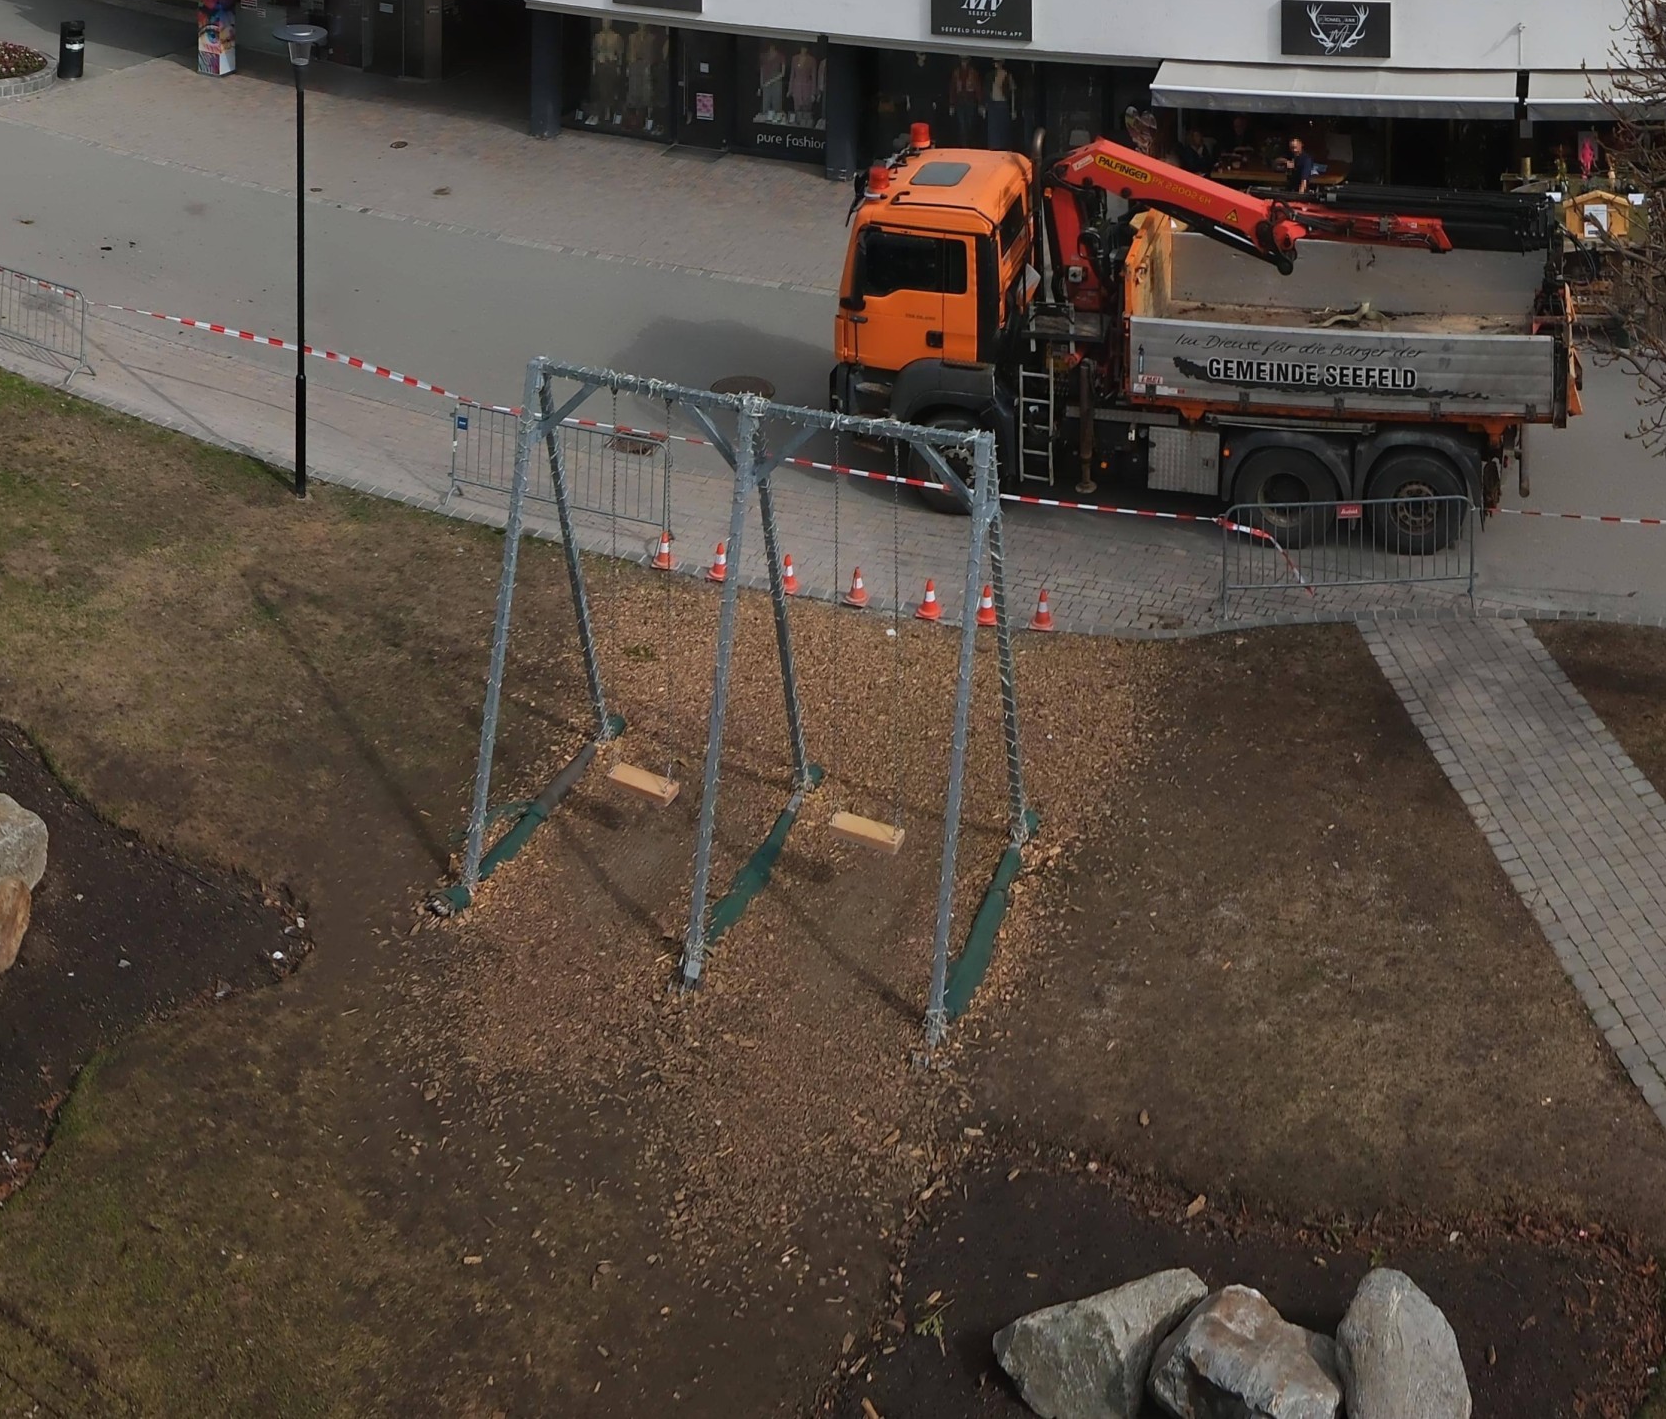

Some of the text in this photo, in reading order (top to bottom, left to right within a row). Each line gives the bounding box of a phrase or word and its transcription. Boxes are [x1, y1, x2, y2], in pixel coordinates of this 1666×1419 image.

[941, 26, 970, 34] SEEFELD
[972, 28, 1007, 36] SHOPPING
[756, 133, 782, 145] pure
[1098, 156, 1148, 181] PALFINGER
[1203, 335, 1260, 352] Dienst
[1261, 339, 1294, 355] für
[1299, 342, 1326, 355] die
[1330, 343, 1388, 362] Bürger
[1393, 346, 1427, 358] der
[1208, 357, 1418, 389] GEMEINDE SEEFELD
